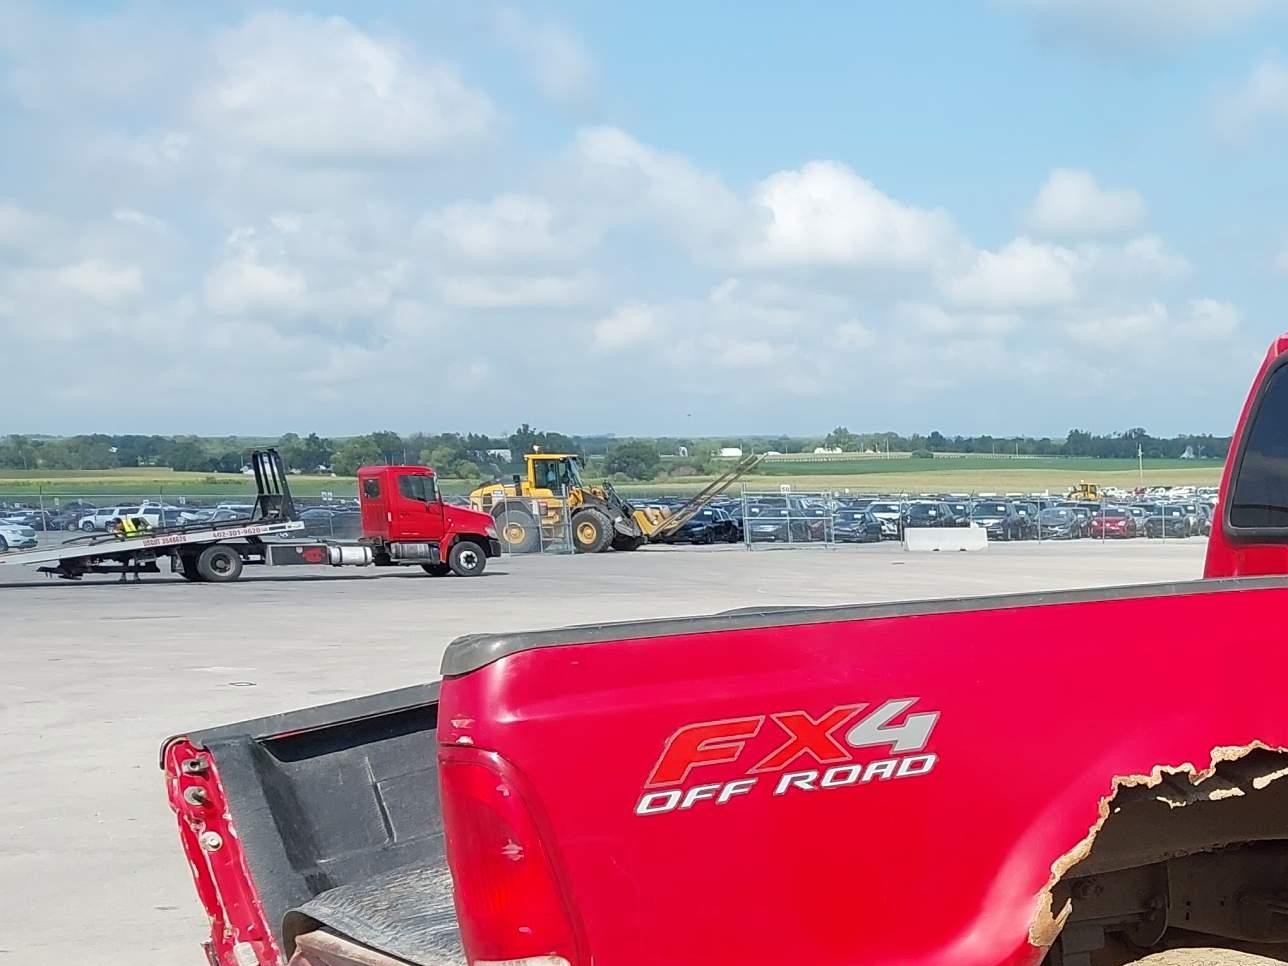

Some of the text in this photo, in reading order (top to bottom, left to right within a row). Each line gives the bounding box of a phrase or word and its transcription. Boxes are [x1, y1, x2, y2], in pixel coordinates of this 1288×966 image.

[645, 697, 941, 788] FX4
[634, 754, 939, 816] OFF ROAD
